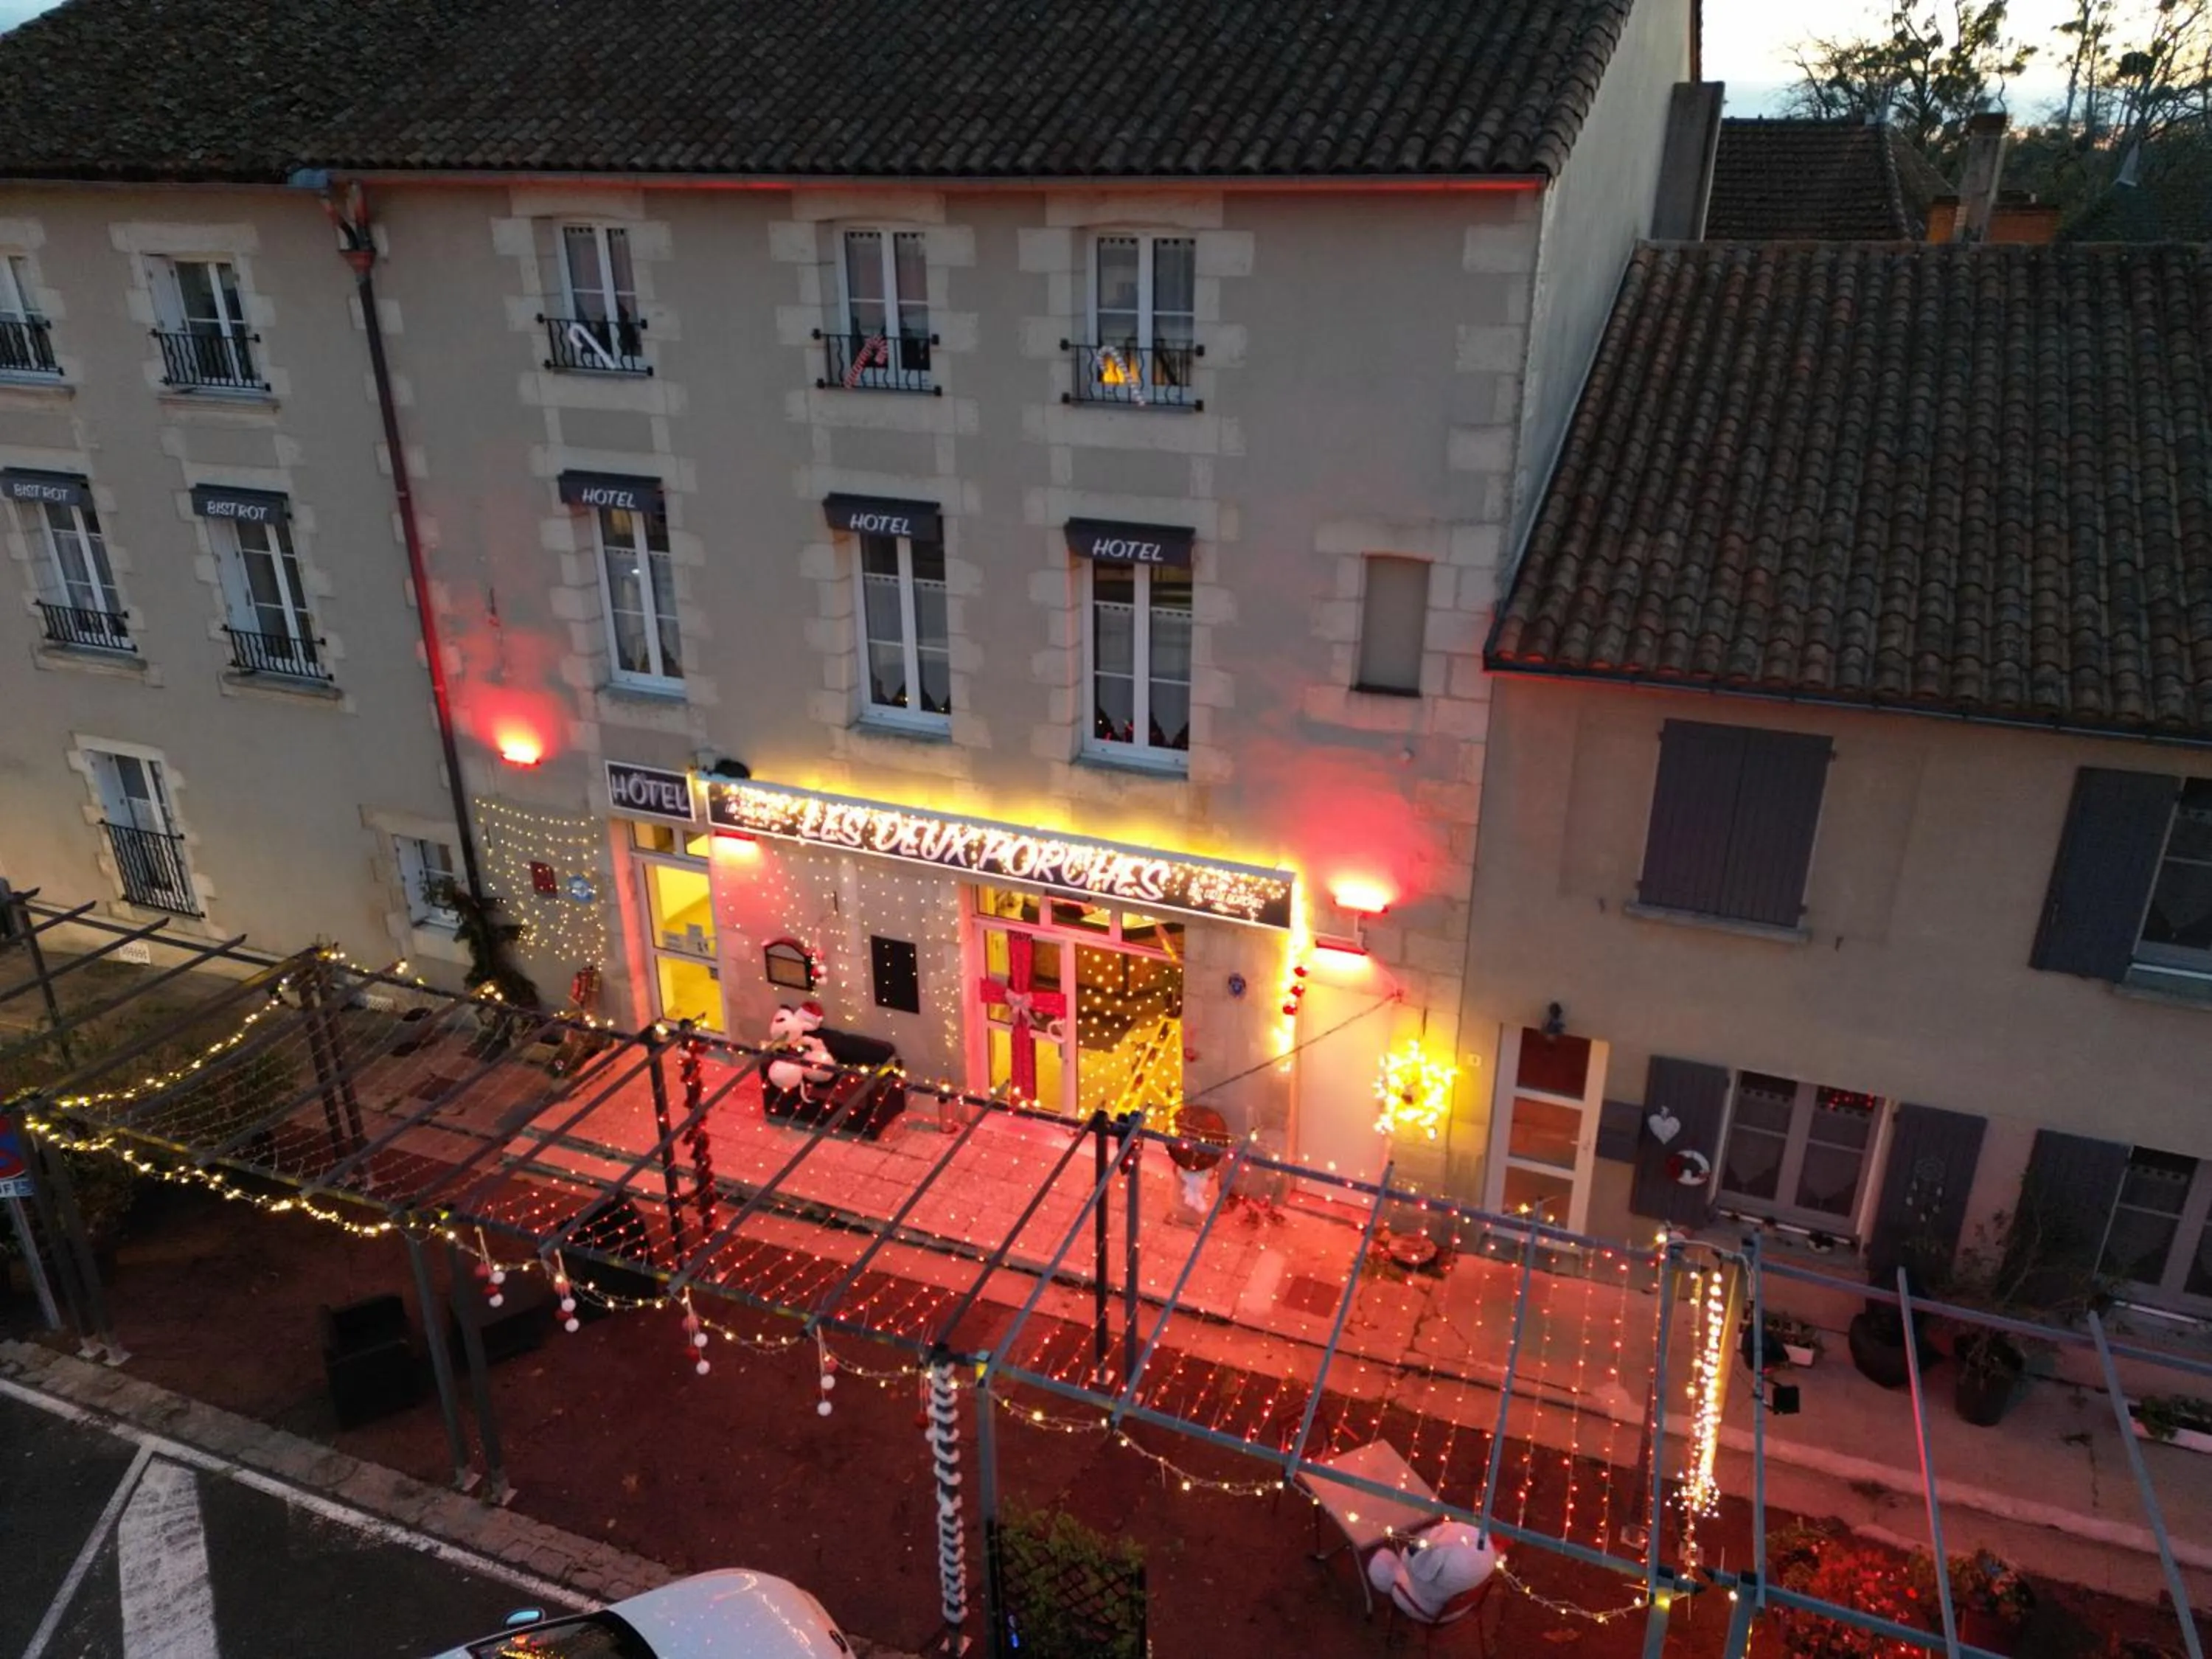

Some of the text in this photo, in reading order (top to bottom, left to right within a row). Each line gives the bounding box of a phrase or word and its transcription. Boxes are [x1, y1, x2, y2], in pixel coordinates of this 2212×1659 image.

[13, 483, 68, 502] BISTROT
[582, 488, 636, 508] HOTEL
[206, 500, 268, 520] BISTROT
[849, 513, 911, 535] HOTEL
[1092, 538, 1164, 562] HOTEL
[801, 797, 866, 846] LES
[873, 811, 970, 867] DEUX
[978, 827, 1171, 901] PORCHES
